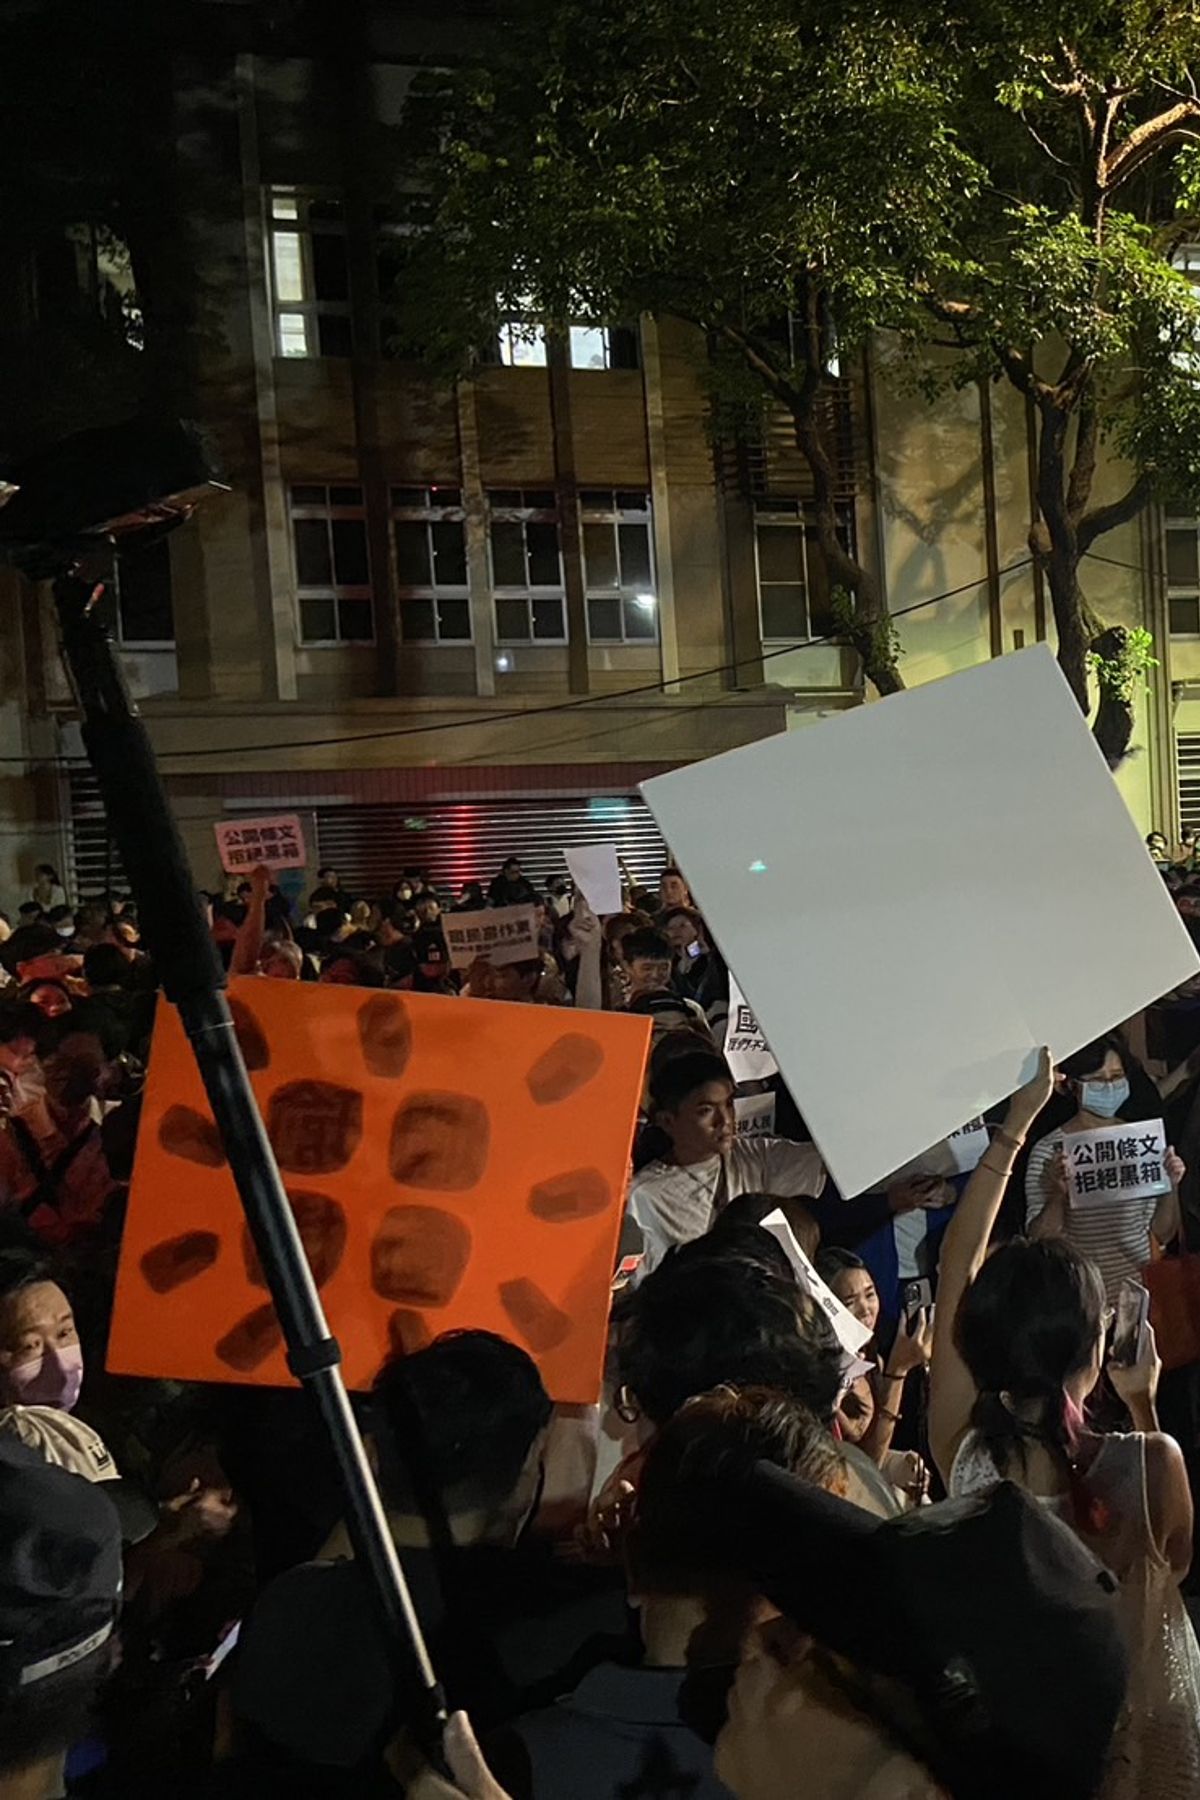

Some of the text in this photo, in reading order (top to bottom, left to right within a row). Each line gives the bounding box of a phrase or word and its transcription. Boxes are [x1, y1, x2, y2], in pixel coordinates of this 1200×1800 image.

[1073, 1133, 1160, 1167] 公開條文
[1075, 1160, 1162, 1194] 拒絕黑箱
